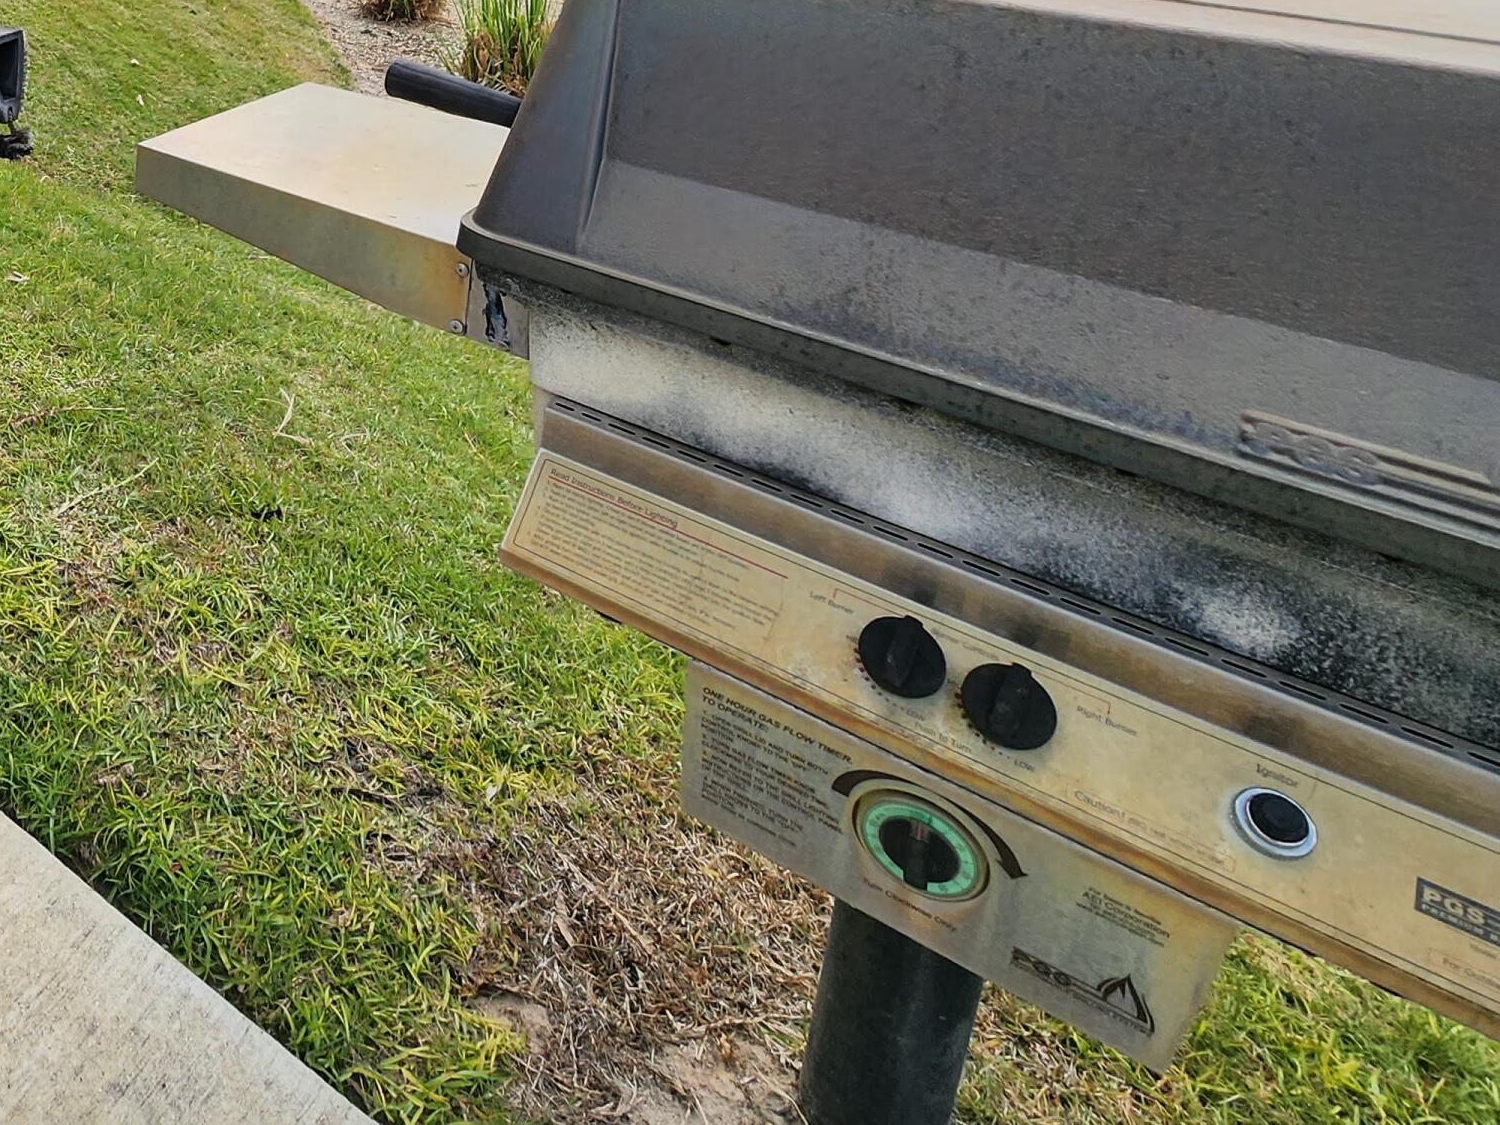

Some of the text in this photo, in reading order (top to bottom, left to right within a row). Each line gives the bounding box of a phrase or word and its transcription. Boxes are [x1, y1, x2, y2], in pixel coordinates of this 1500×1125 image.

[702, 696, 715, 706] TO
[703, 687, 725, 701] ONE
[726, 698, 757, 718] HOUR
[758, 713, 780, 729] GAS
[783, 725, 814, 745] FLOW
[1423, 888, 1485, 925] PGS
